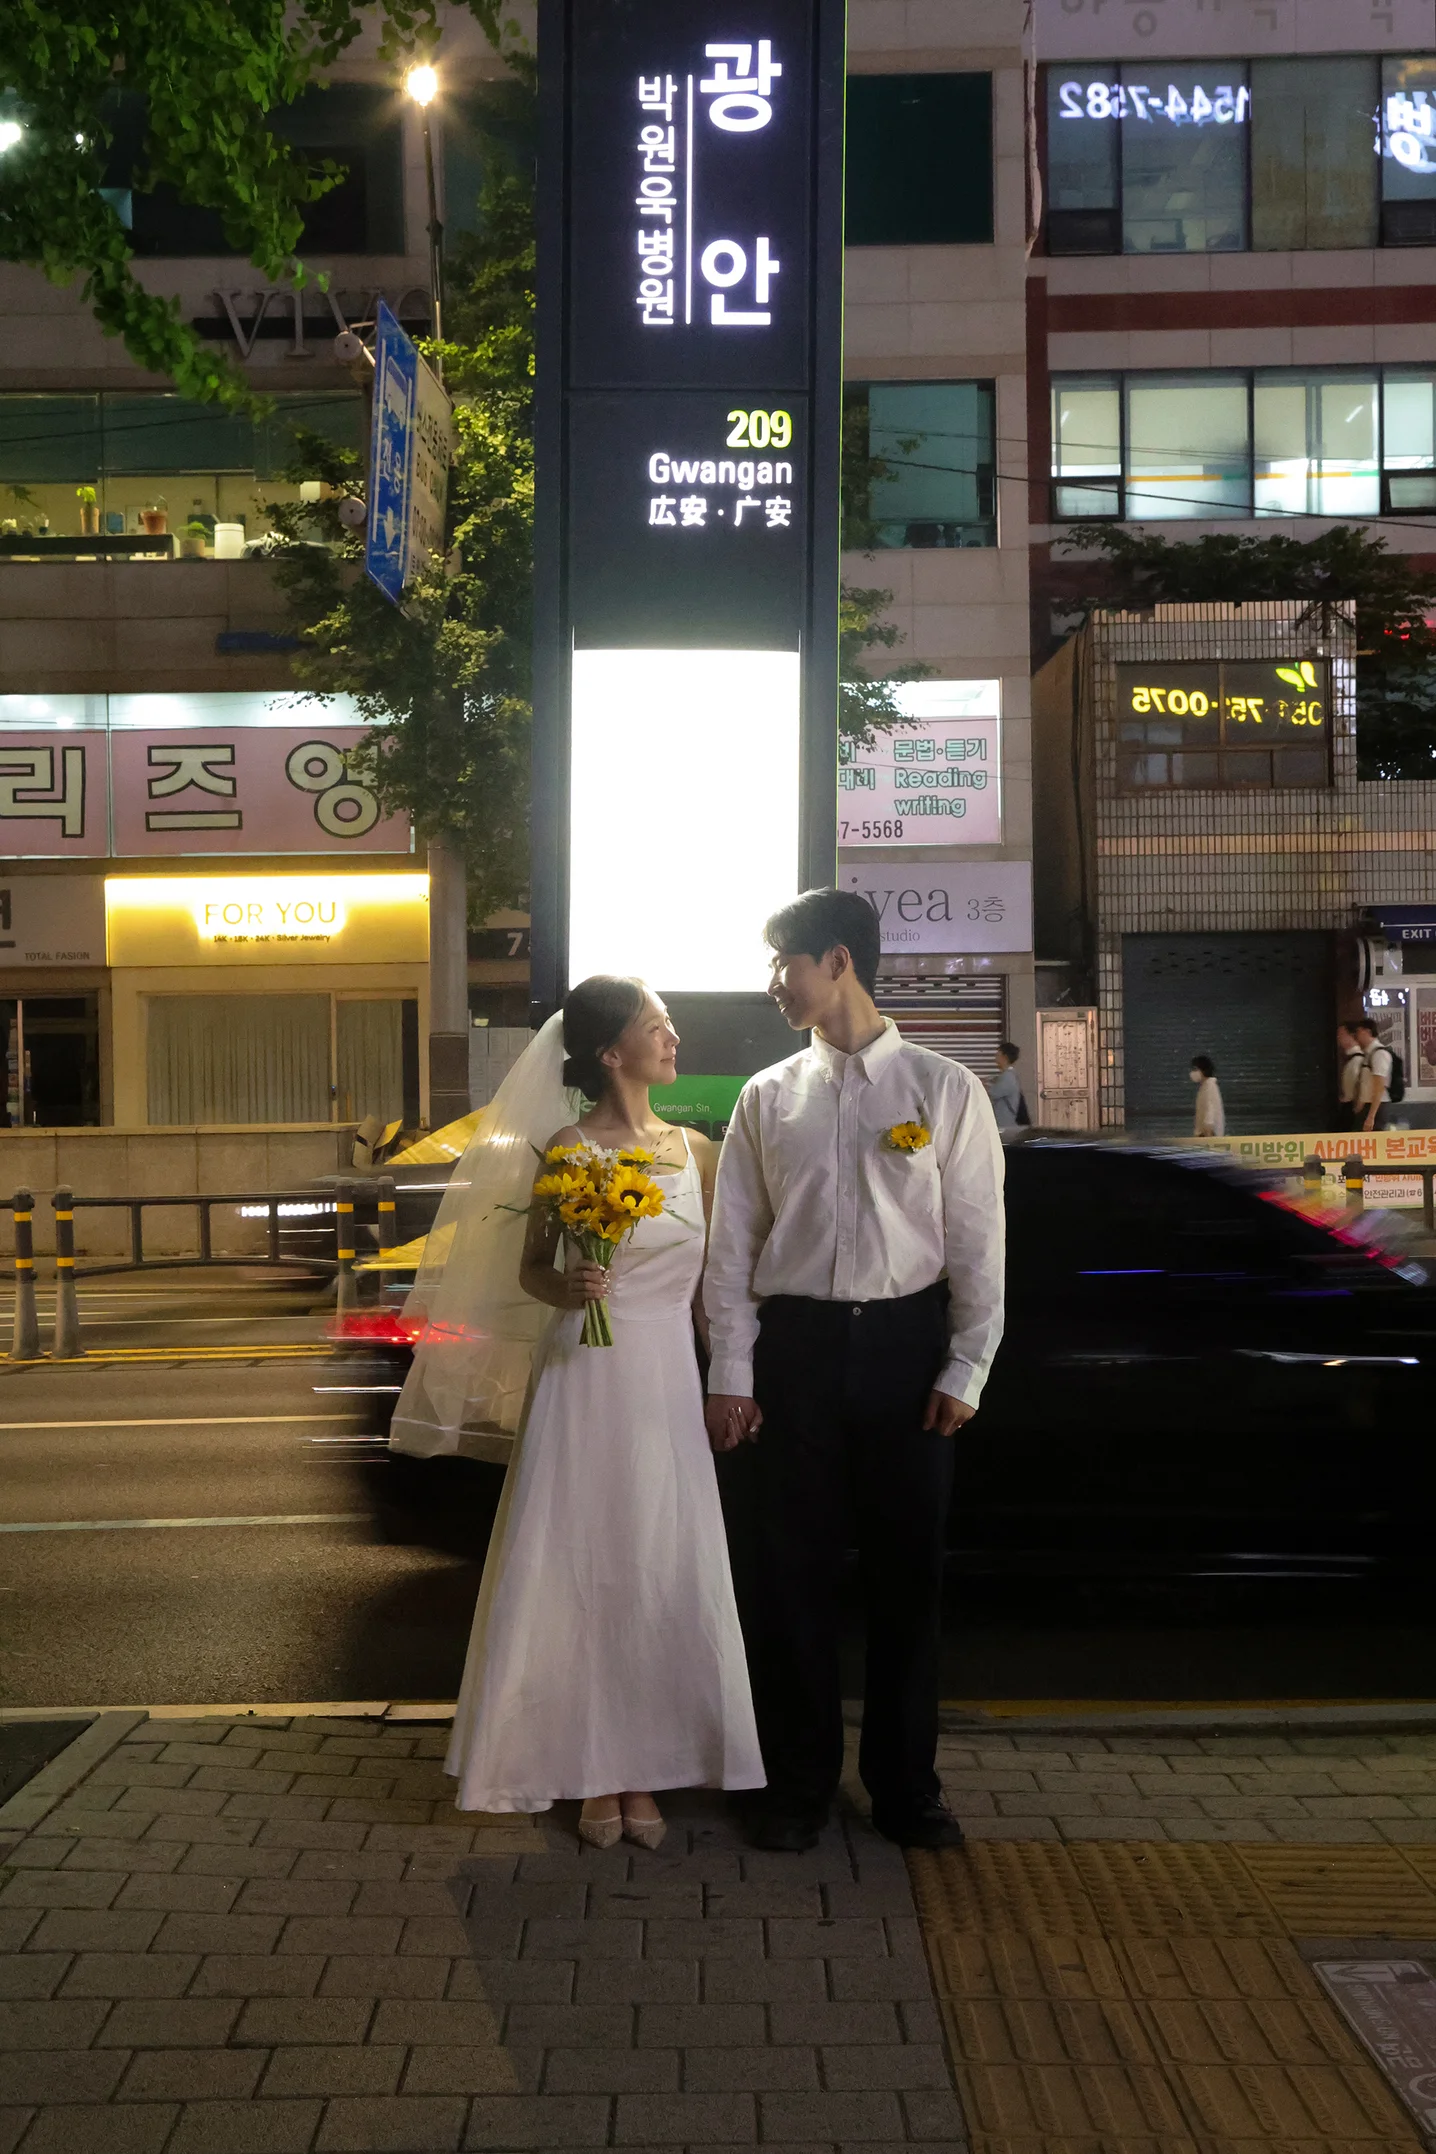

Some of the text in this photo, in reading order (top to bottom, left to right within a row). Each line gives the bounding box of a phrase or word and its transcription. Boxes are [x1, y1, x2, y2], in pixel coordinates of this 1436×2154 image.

[700, 40, 782, 325] 광안
[635, 74, 678, 324] 박원욱병원
[726, 410, 792, 448] 209
[649, 452, 792, 490] Gwangan
[894, 767, 987, 789] Reading
[894, 796, 966, 817] writing
[838, 820, 903, 839] 7-5568
[205, 901, 336, 925] FOR YOU
[966, 896, 1006, 923] 3층
[276, 934, 298, 942] Silver
[300, 934, 331, 943] Jewelry
[880, 929, 920, 942] studio
[1402, 928, 1432, 939] EXIT
[24, 951, 90, 961] TOTAL FASION
[653, 1102, 693, 1114] Gwangan
[1240, 1141, 1304, 1164] 민방위
